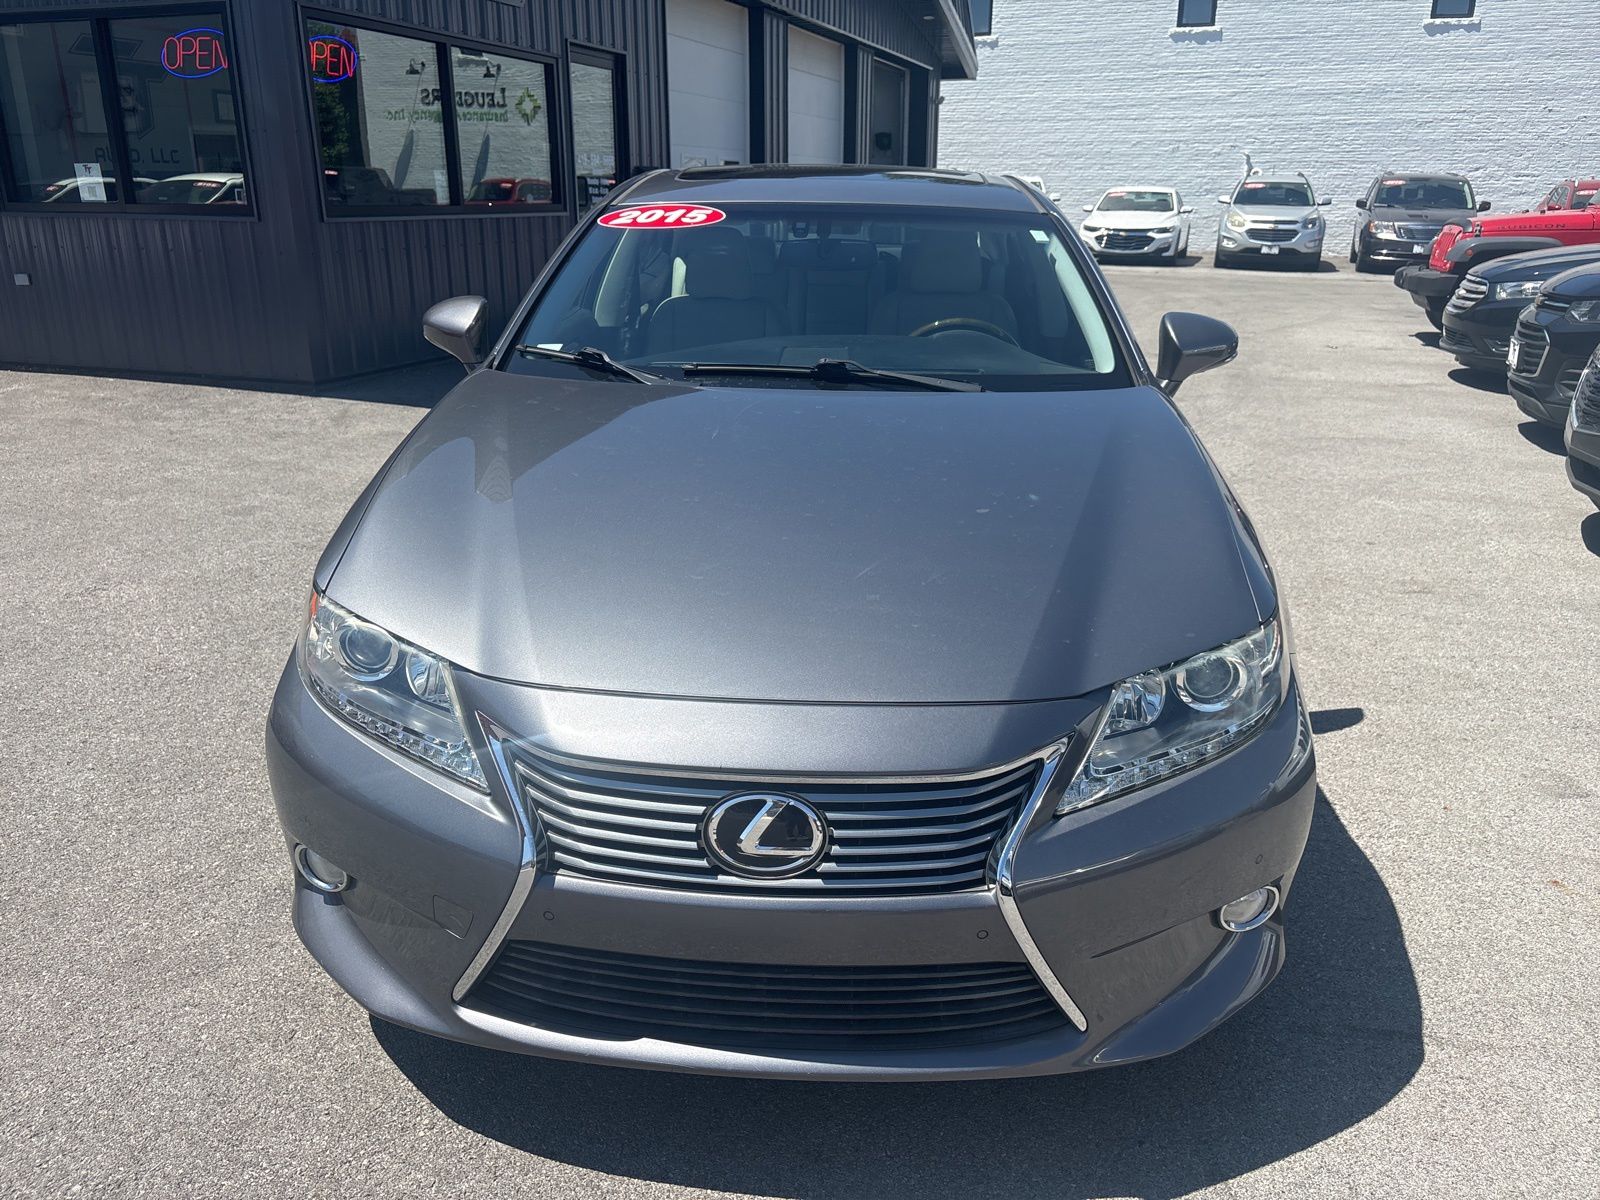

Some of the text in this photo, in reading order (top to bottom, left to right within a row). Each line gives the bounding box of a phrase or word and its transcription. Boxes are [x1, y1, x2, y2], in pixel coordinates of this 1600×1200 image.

[164, 36, 229, 70] OPEN
[608, 208, 714, 225] 2015
[1497, 223, 1566, 231] RUBICON
